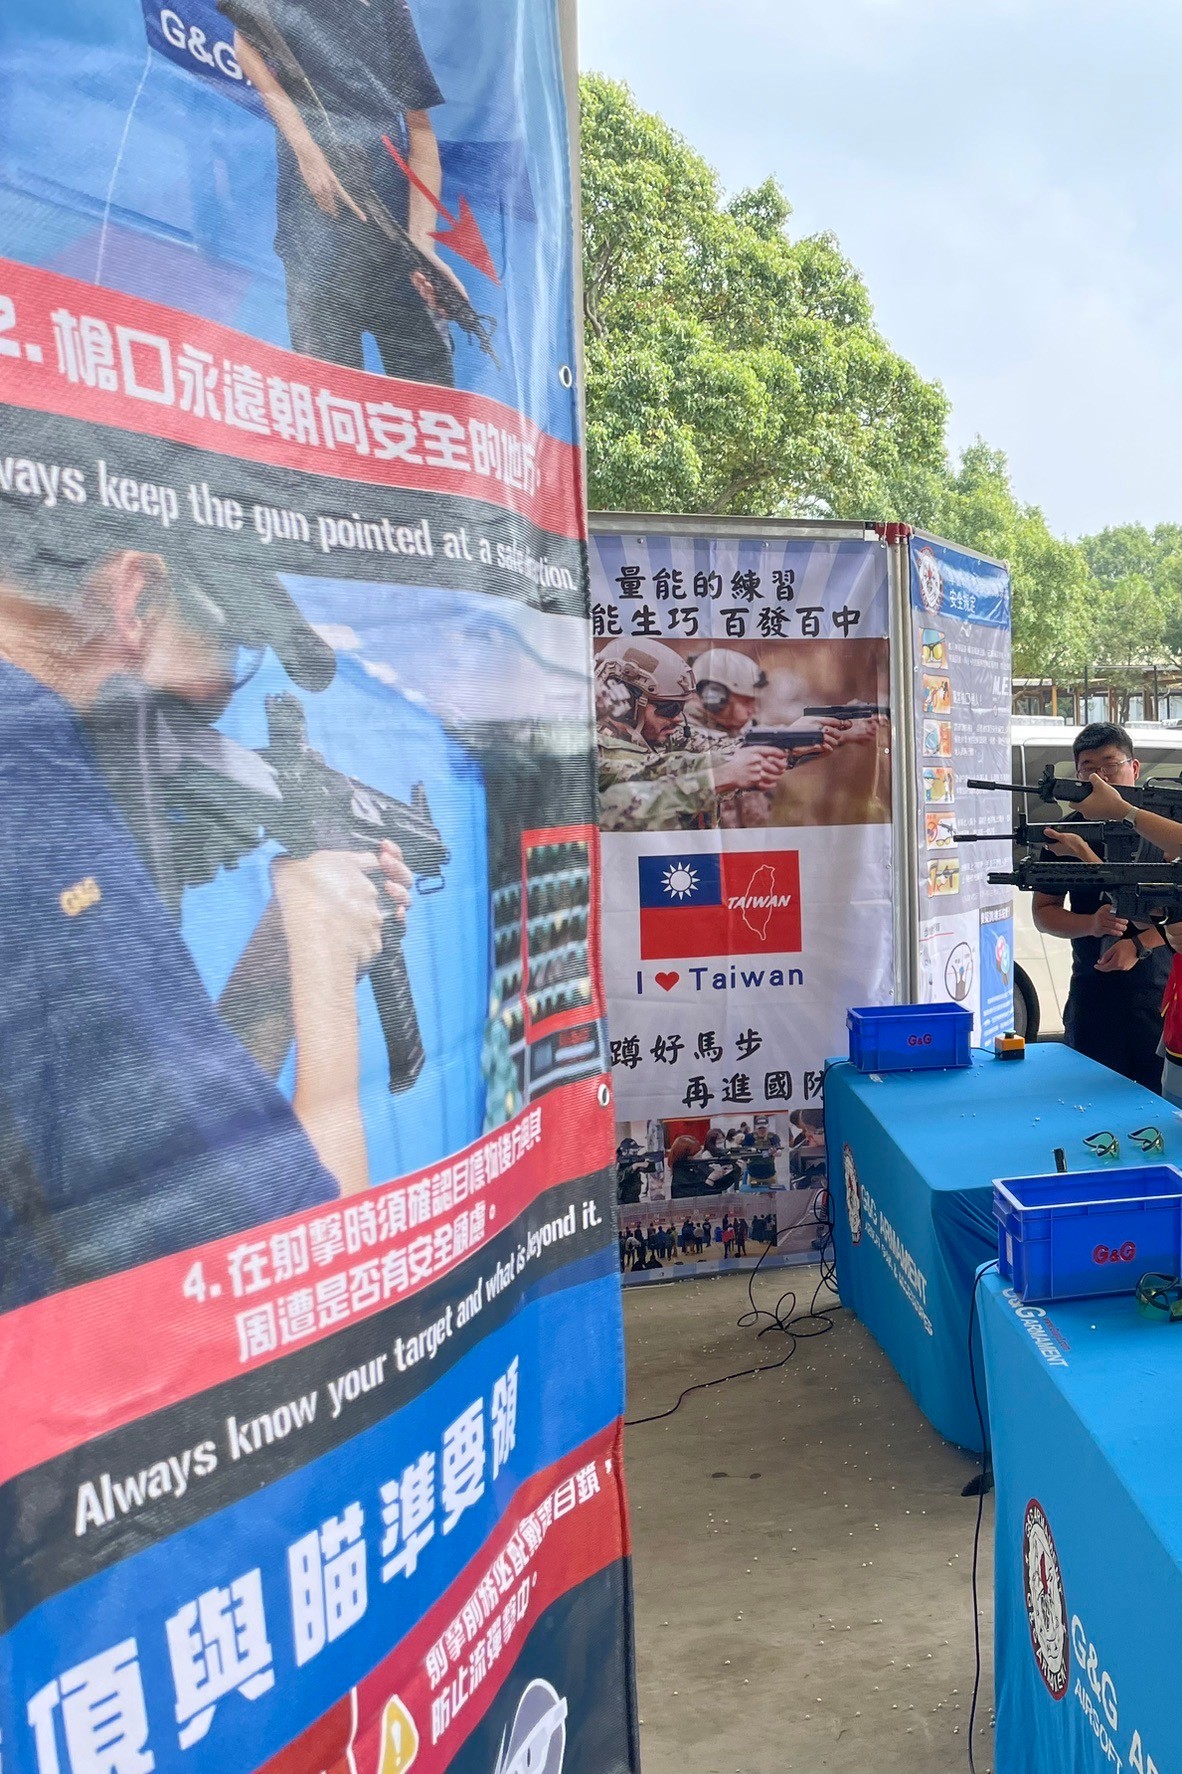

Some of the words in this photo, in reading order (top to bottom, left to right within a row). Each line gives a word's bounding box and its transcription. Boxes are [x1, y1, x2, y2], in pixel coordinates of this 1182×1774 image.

[97, 460, 179, 528] keep
[188, 482, 244, 531] the
[253, 504, 310, 544] gun
[317, 512, 433, 556] pointed
[442, 526, 472, 561] at
[479, 537, 493, 565] a
[615, 565, 796, 602] 量能的練習
[719, 605, 862, 638] 百發百中
[727, 894, 792, 910] TAIWAN
[688, 965, 804, 991] Taiwan
[609, 1028, 763, 1069] 蹲好馬步
[908, 1034, 933, 1046] G&G
[1092, 1241, 1136, 1265] G&G
[75, 1441, 217, 1537] Always
[226, 1391, 318, 1461] know
[327, 1353, 387, 1419] your
[394, 1305, 453, 1372] target
[456, 1277, 483, 1329] and
[485, 1251, 516, 1302] what
[517, 1244, 526, 1275] is
[526, 1204, 576, 1260] beyond
[582, 1199, 602, 1230] it.
[1071, 1614, 1118, 1731] G&G
